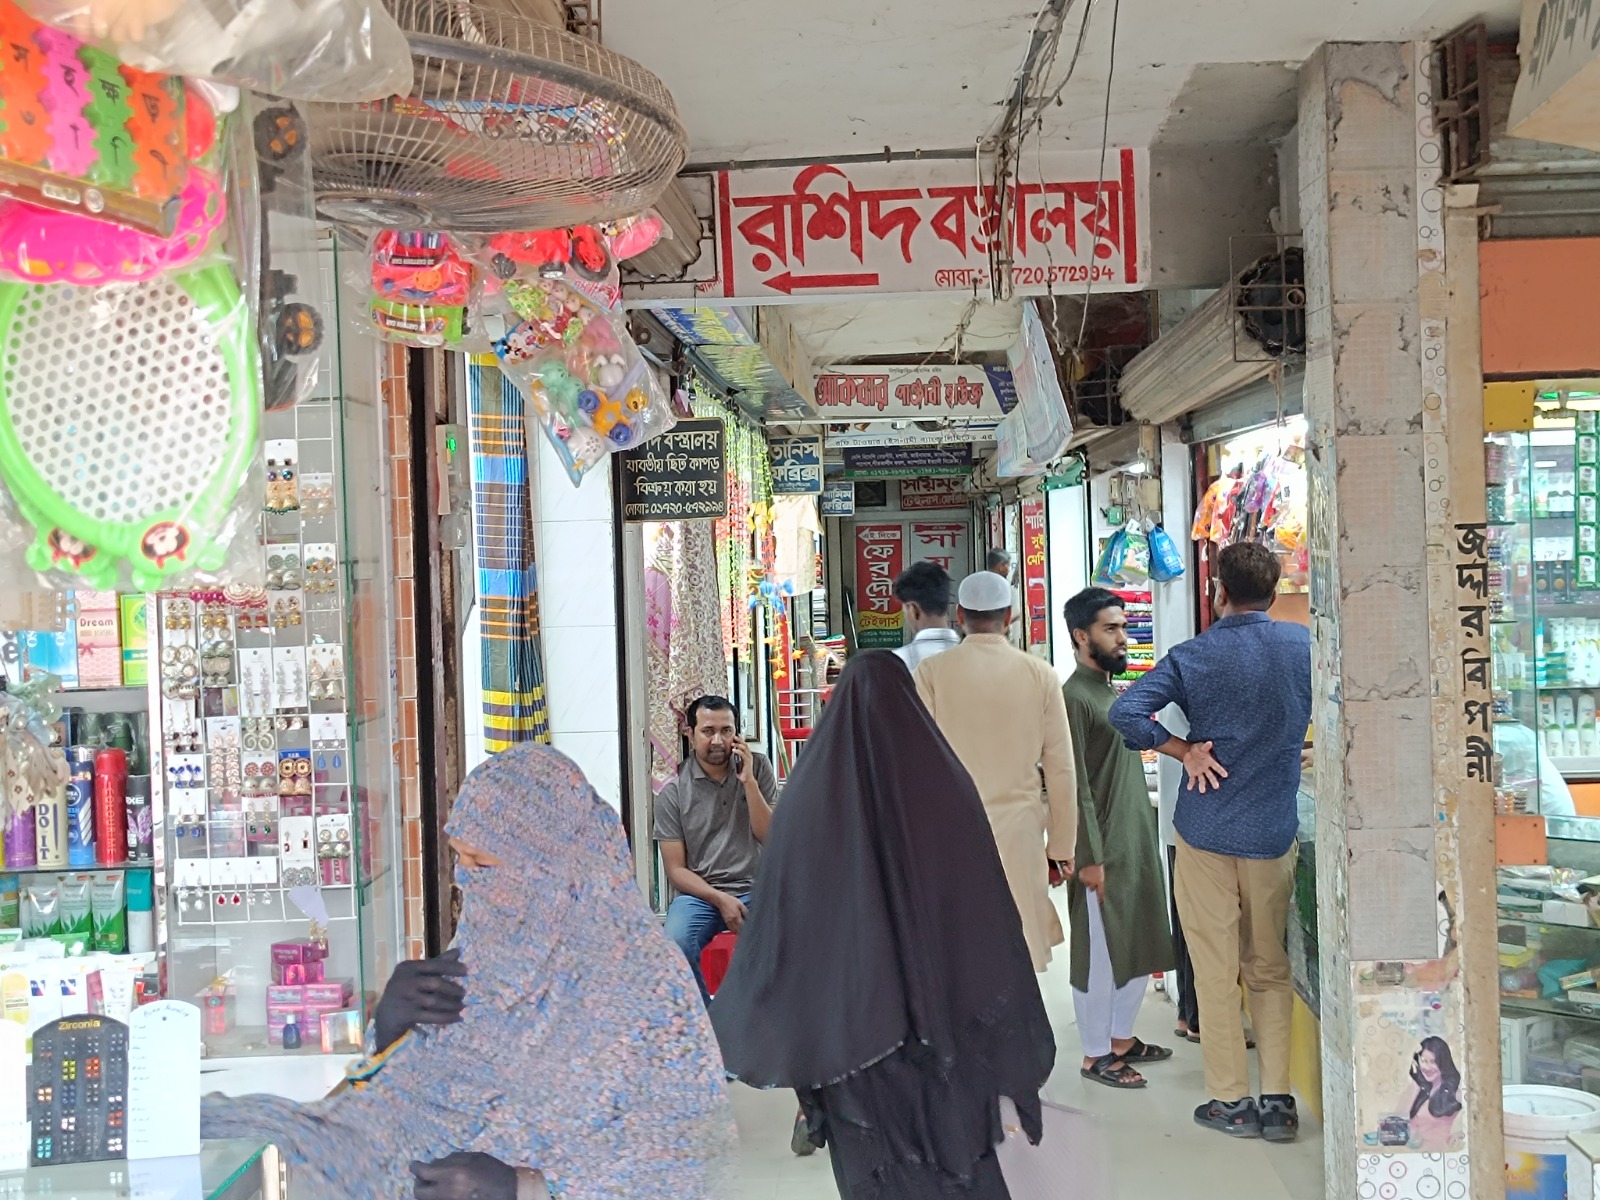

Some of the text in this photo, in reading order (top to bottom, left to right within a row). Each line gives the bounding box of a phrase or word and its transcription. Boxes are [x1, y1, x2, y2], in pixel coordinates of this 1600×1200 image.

[732, 164, 1122, 272] রশিদ বস্ত্রালয়
[944, 375, 984, 409] হাউজ
[663, 430, 720, 451] বস্ত্রালয়
[626, 452, 720, 474] যাবতীয় ছিট কাপড়
[634, 476, 718, 497] বিক্রয় করা হয়
[79, 617, 114, 628] Dream
[859, 613, 901, 628] টেইলার্স
[39, 804, 50, 860] DO IT
[58, 1018, 100, 1031] Zirconia
